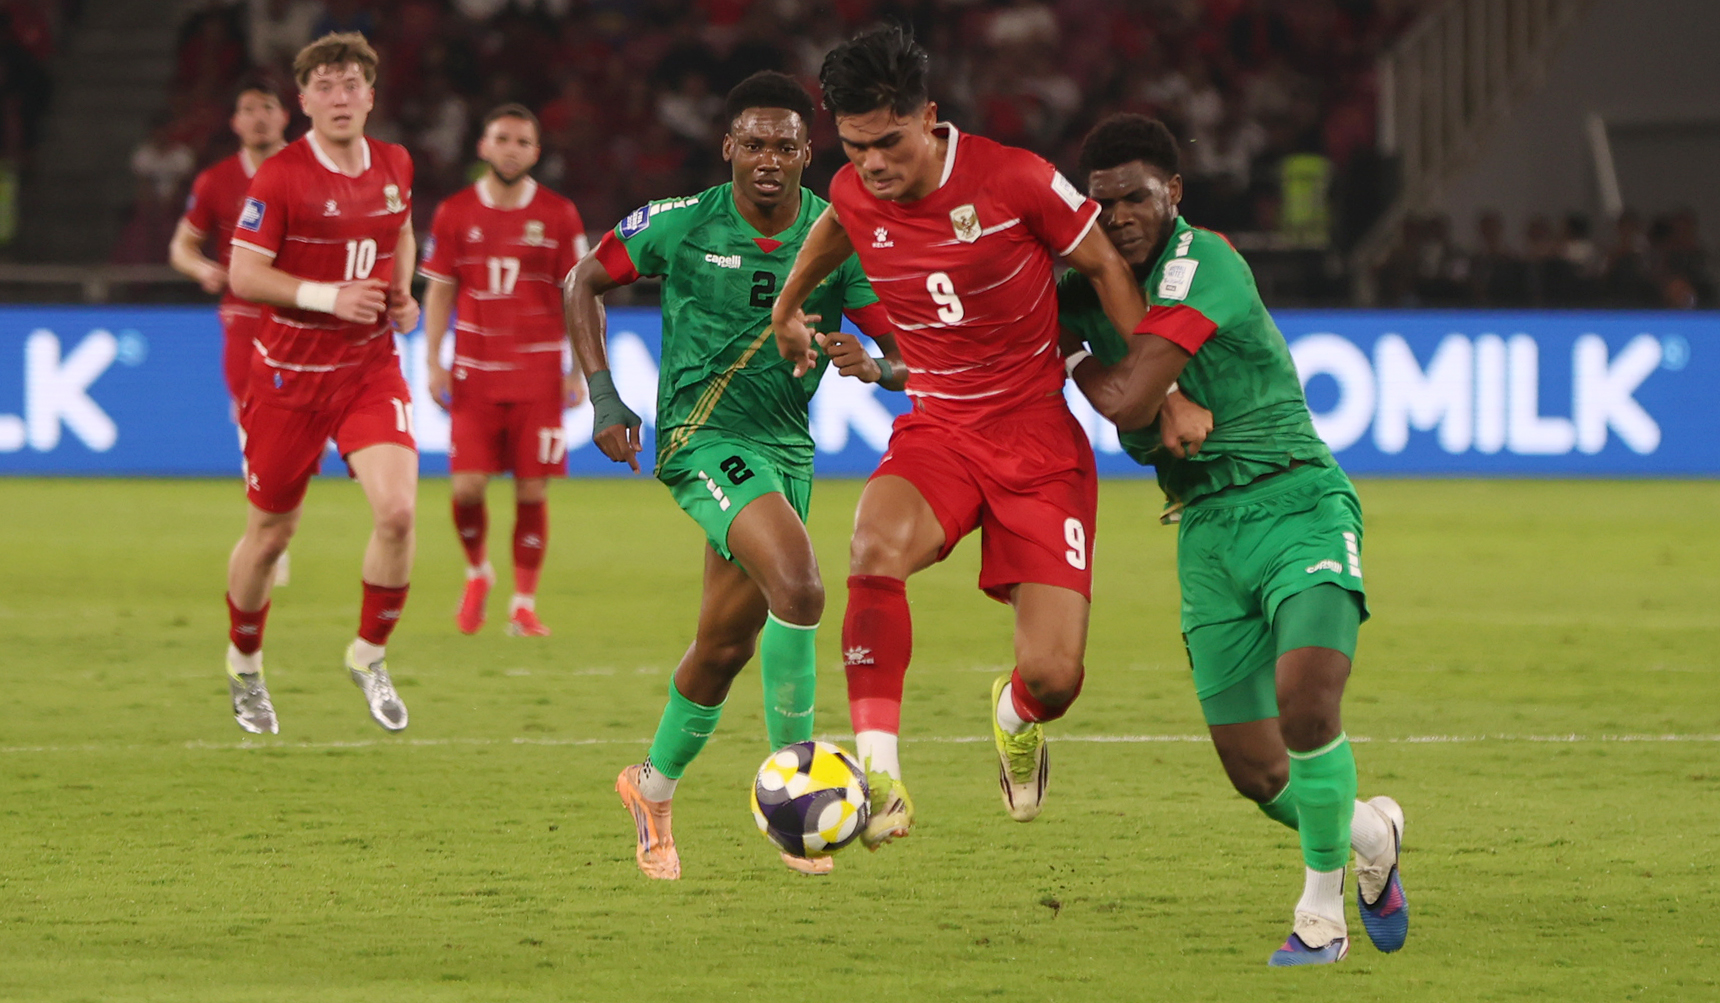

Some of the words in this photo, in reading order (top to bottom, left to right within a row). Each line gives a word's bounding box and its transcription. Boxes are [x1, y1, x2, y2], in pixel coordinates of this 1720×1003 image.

[344, 239, 377, 280] 10
[487, 256, 520, 295] 17
[704, 254, 741, 269] capelli
[749, 270, 776, 308] 2
[926, 271, 965, 324] 9
[0, 328, 118, 453] K
[1283, 333, 1663, 455] OMILK
[537, 427, 566, 465] 17
[720, 455, 755, 486] 2
[1064, 517, 1087, 570] 9
